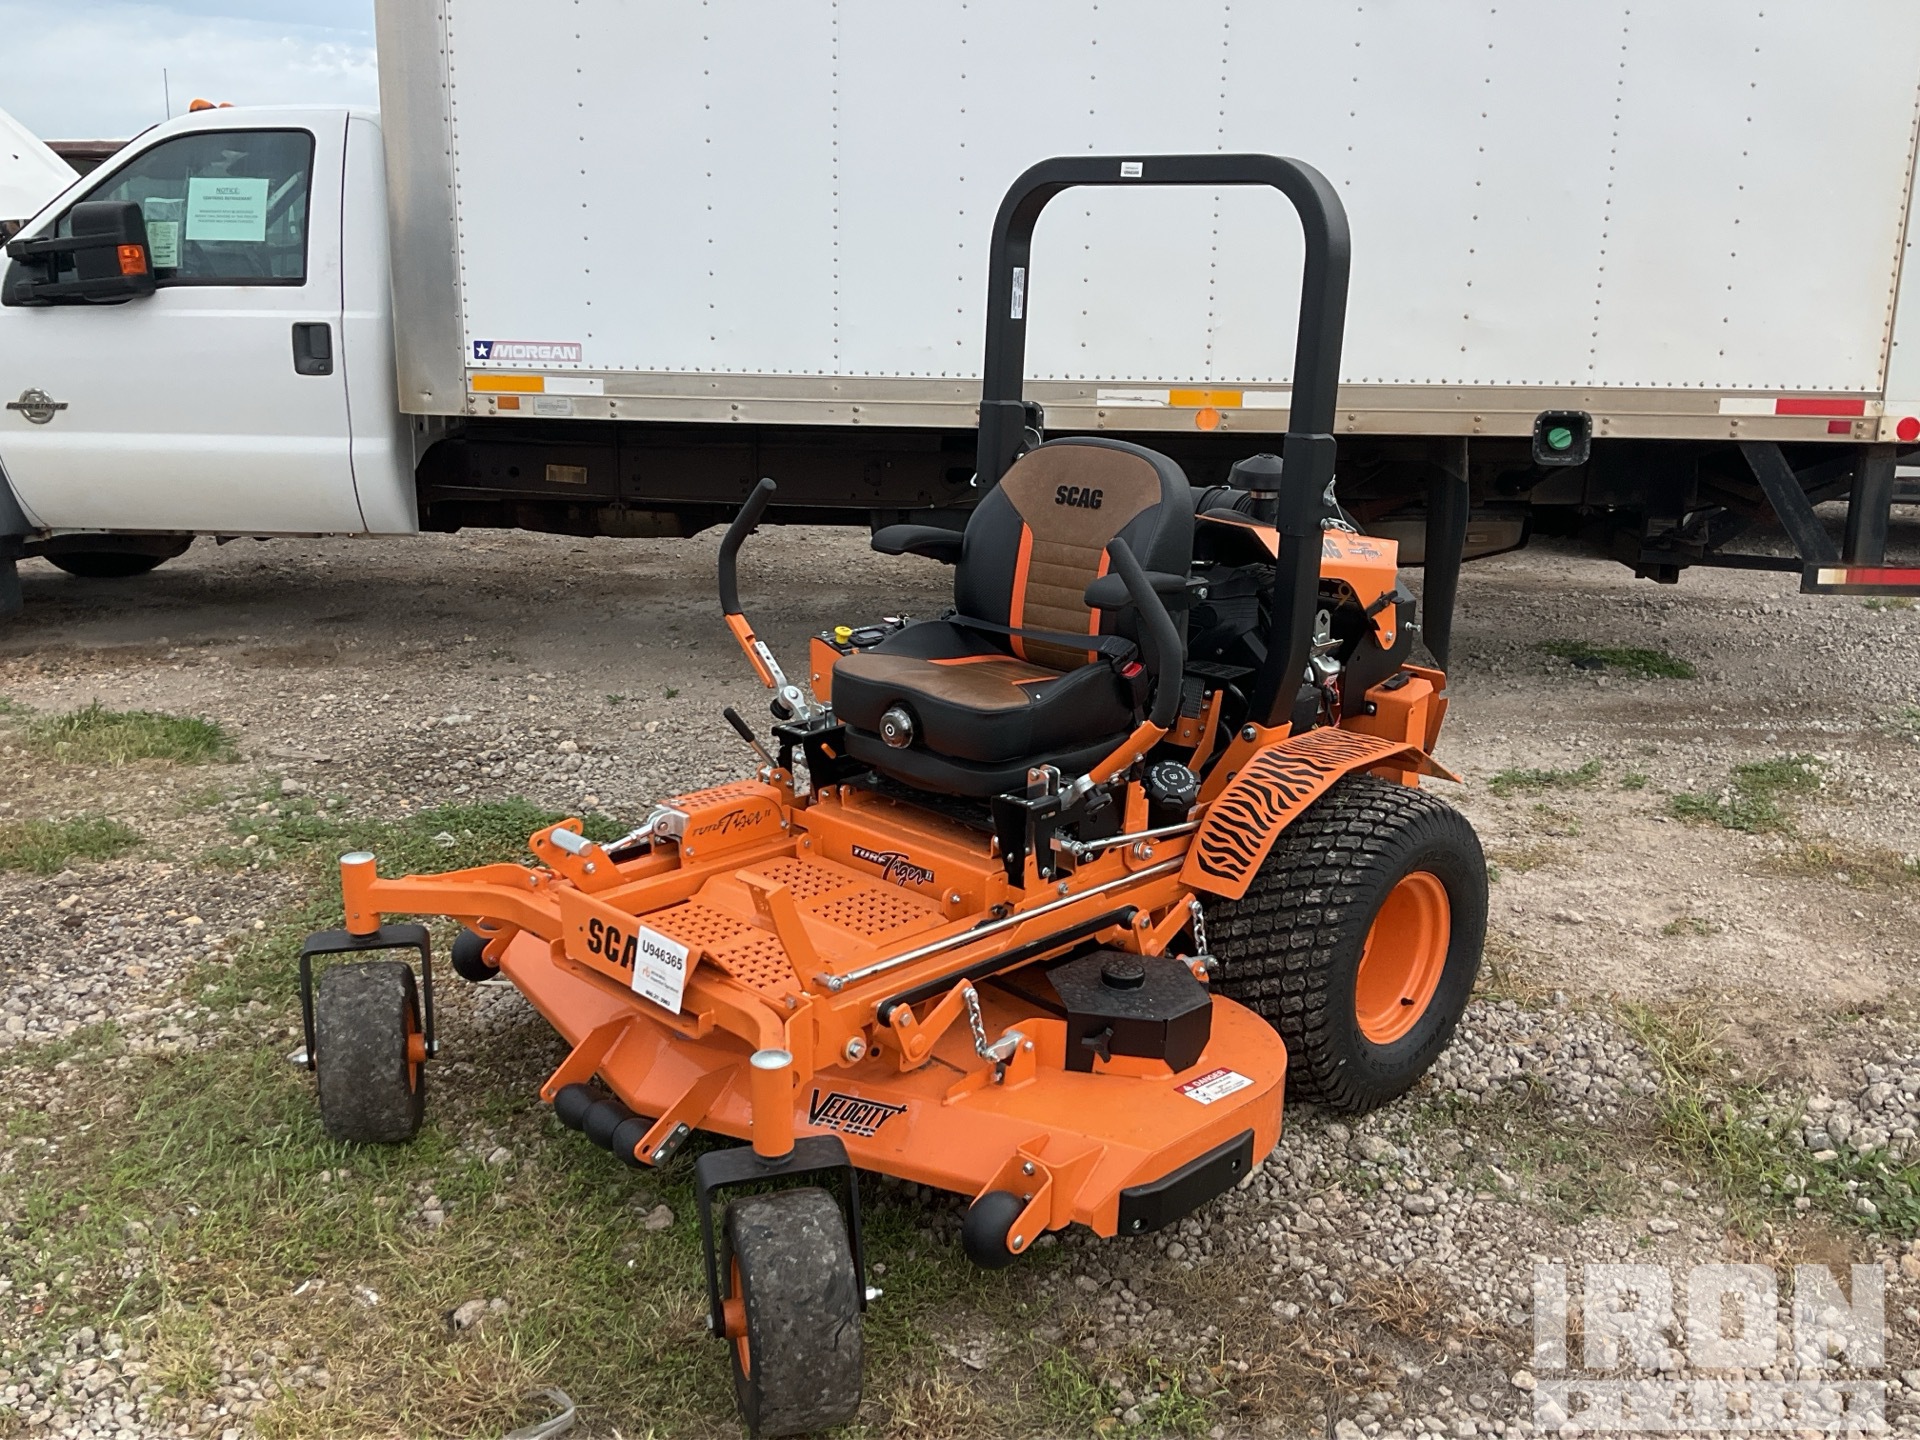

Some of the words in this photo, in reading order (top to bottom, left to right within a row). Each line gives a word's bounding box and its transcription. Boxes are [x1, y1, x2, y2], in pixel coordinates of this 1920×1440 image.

[493, 344, 577, 360] MORGAN
[1054, 485, 1104, 509] SCAG
[720, 809, 763, 834] Tiger
[853, 846, 886, 865] TURF
[880, 850, 926, 887] Tiger
[587, 917, 637, 968] SCA
[642, 940, 683, 971] U946365
[1192, 1069, 1227, 1087] DANGER
[808, 1088, 907, 1128] VELOCITY
[815, 1116, 876, 1137] PLUS
